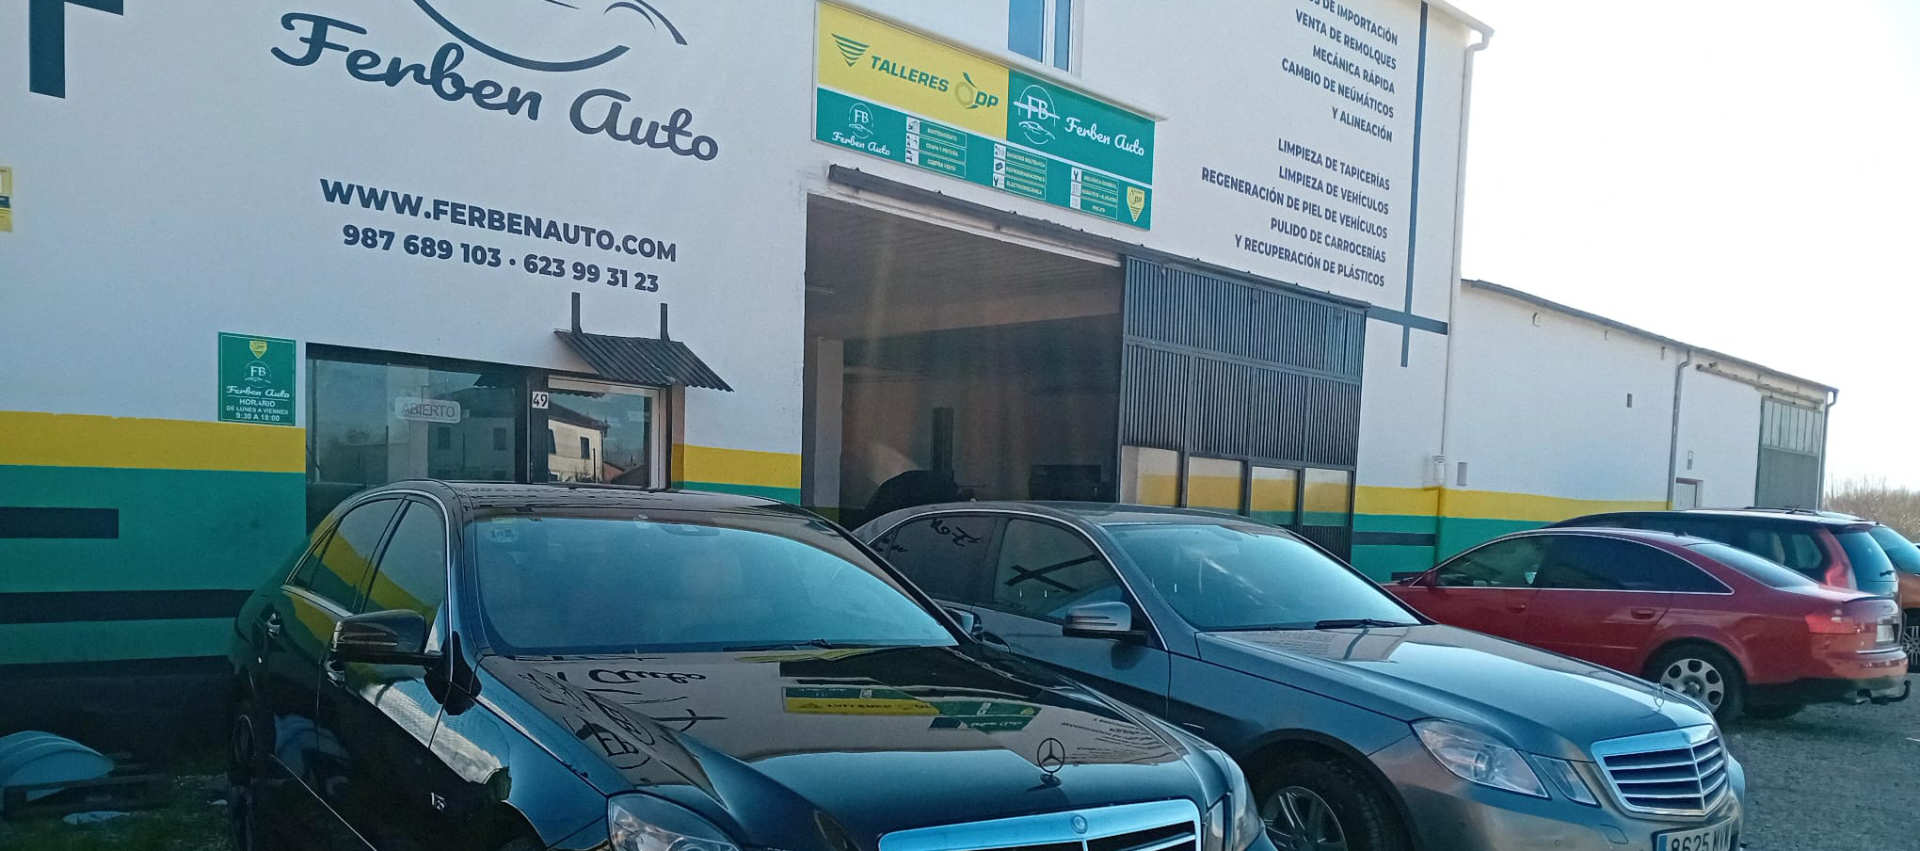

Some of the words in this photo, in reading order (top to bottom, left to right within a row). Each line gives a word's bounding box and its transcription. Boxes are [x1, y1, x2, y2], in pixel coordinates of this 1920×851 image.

[1296, 8, 1327, 36] VENTA
[1329, 26, 1342, 43] DE
[1343, 34, 1397, 70] REMOLQUES
[1323, 0, 1335, 13] DE
[1337, 4, 1398, 45] IMPORTACIÓN
[270, 12, 544, 121] Ferben
[569, 88, 719, 161] Auto
[871, 55, 950, 92] TALLERES
[1281, 58, 1321, 85] CAMBIO
[1323, 76, 1336, 92] DE
[1312, 45, 1360, 78] MECÁNICA
[1362, 69, 1395, 94] RÁPIDA
[854, 109, 869, 124] FB
[1064, 116, 1111, 145] Ferben
[1114, 134, 1145, 157] Auto
[1332, 106, 1338, 119] Y
[1340, 110, 1393, 142] ALINEACIÓN
[832, 131, 865, 149] Ferben
[867, 141, 891, 156] Auto
[1278, 138, 1323, 166] LIMPIEZA
[1325, 156, 1338, 171] DE
[1340, 161, 1390, 190] TAPICERÍAS
[1201, 167, 1284, 203] REGENERACIÓN
[1286, 196, 1300, 211] DE
[1302, 201, 1322, 218] PIEL
[1324, 208, 1337, 223] DE
[1339, 212, 1388, 239] VEHÍCULOS
[1279, 165, 1323, 192] LIMPIEZA
[1326, 182, 1338, 197] DE
[1340, 187, 1389, 215] VEHÍCULOS
[319, 178, 677, 263] WWW.FERBENAUTO.COM
[1270, 217, 1307, 239] PULIDO
[1309, 229, 1322, 244] DE
[1324, 234, 1386, 263] CARROCERÍAS
[342, 224, 395, 251] 987
[403, 234, 453, 260] 689
[460, 243, 501, 268] 103
[523, 253, 566, 278] 623
[572, 262, 600, 283] 99
[606, 267, 628, 288] 31
[634, 272, 659, 293] 23
[1235, 234, 1243, 248] Y
[1244, 237, 1321, 267] RECUPERACIÓN
[1323, 259, 1336, 274] DE
[1337, 263, 1385, 287] PLÁSTICOS
[226, 385, 262, 396] Ferben
[264, 388, 290, 398] Auto
[250, 366, 266, 377] FB
[400, 403, 456, 418] ABIERTO
[532, 392, 548, 408] 49
